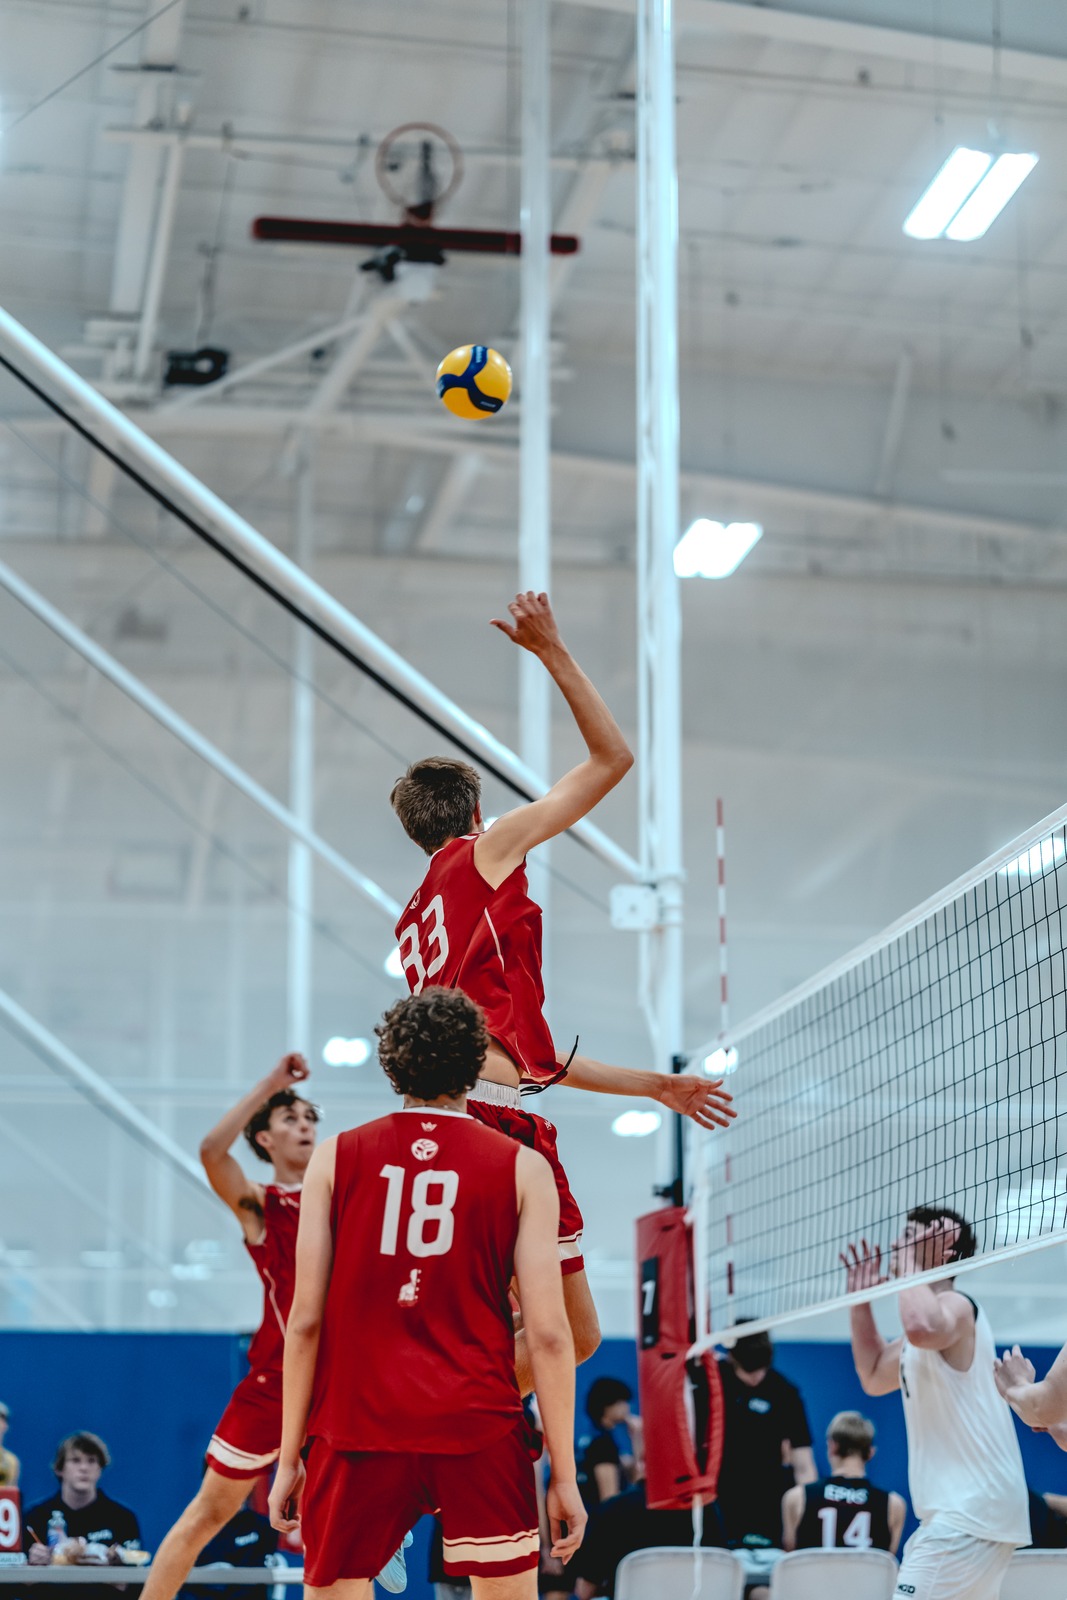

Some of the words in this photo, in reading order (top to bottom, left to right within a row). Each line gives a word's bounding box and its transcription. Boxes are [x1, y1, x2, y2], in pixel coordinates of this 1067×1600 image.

[379, 1164, 460, 1258] 18
[641, 1279, 657, 1316] 1
[817, 1506, 873, 1549] 14
